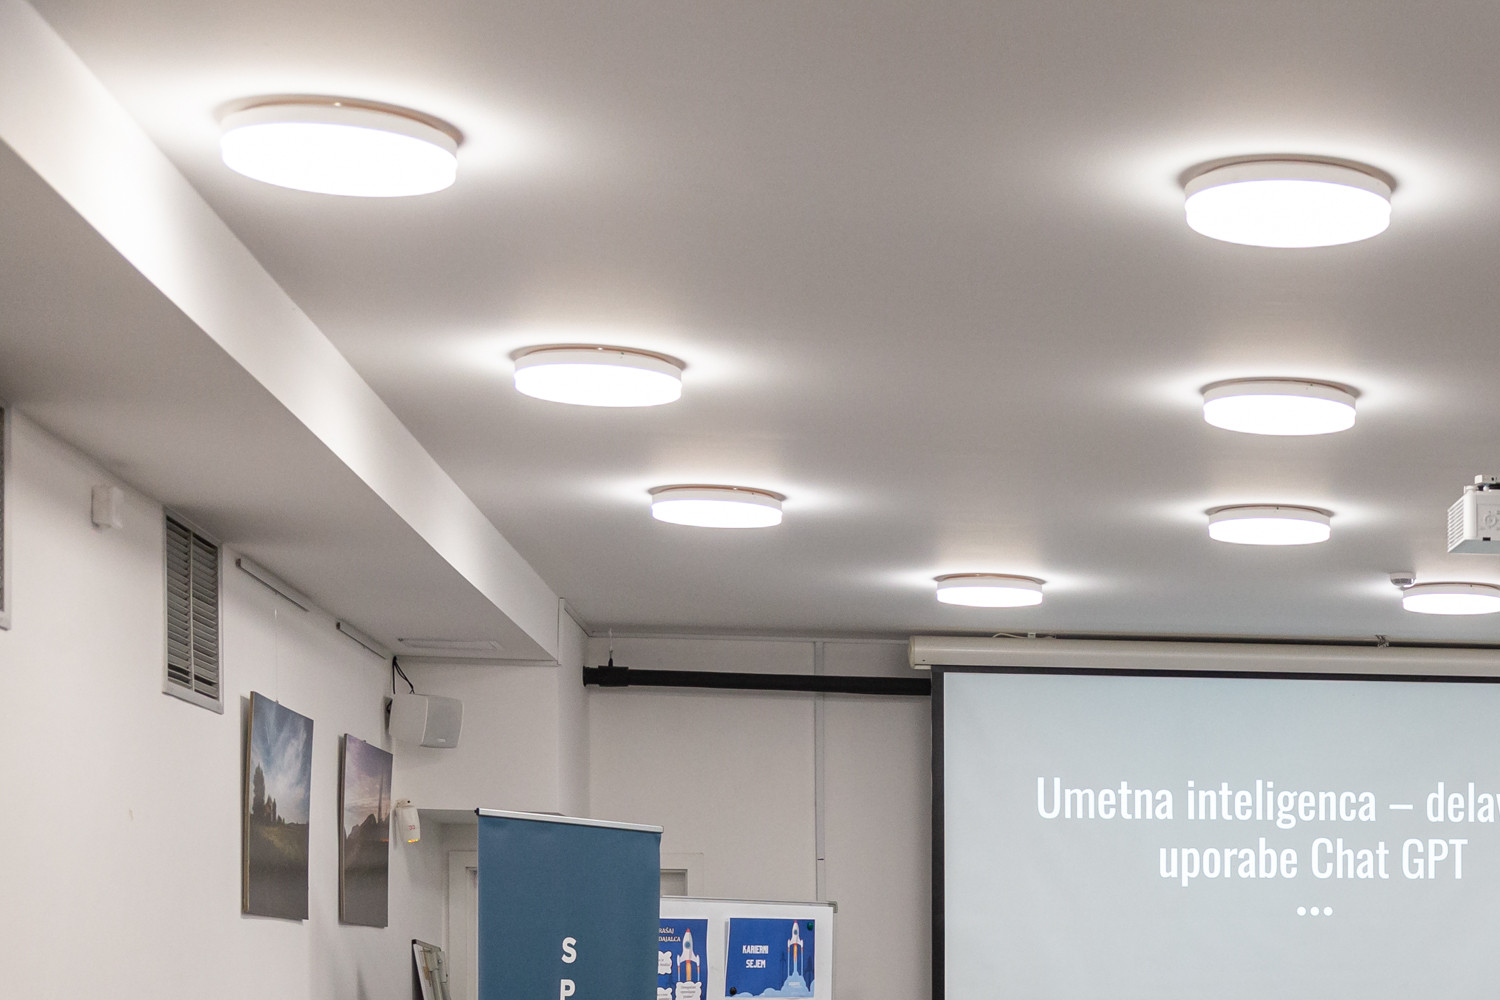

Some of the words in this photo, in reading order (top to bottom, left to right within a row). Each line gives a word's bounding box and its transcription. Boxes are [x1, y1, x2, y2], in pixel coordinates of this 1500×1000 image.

[1037, 776, 1174, 820] Umetna
[1187, 779, 1377, 830] inteligenca
[1159, 837, 1299, 887] uporabe
[1311, 837, 1390, 879] Chat
[1402, 838, 1469, 880] GPT
[745, 959, 766, 968] SEJEM
